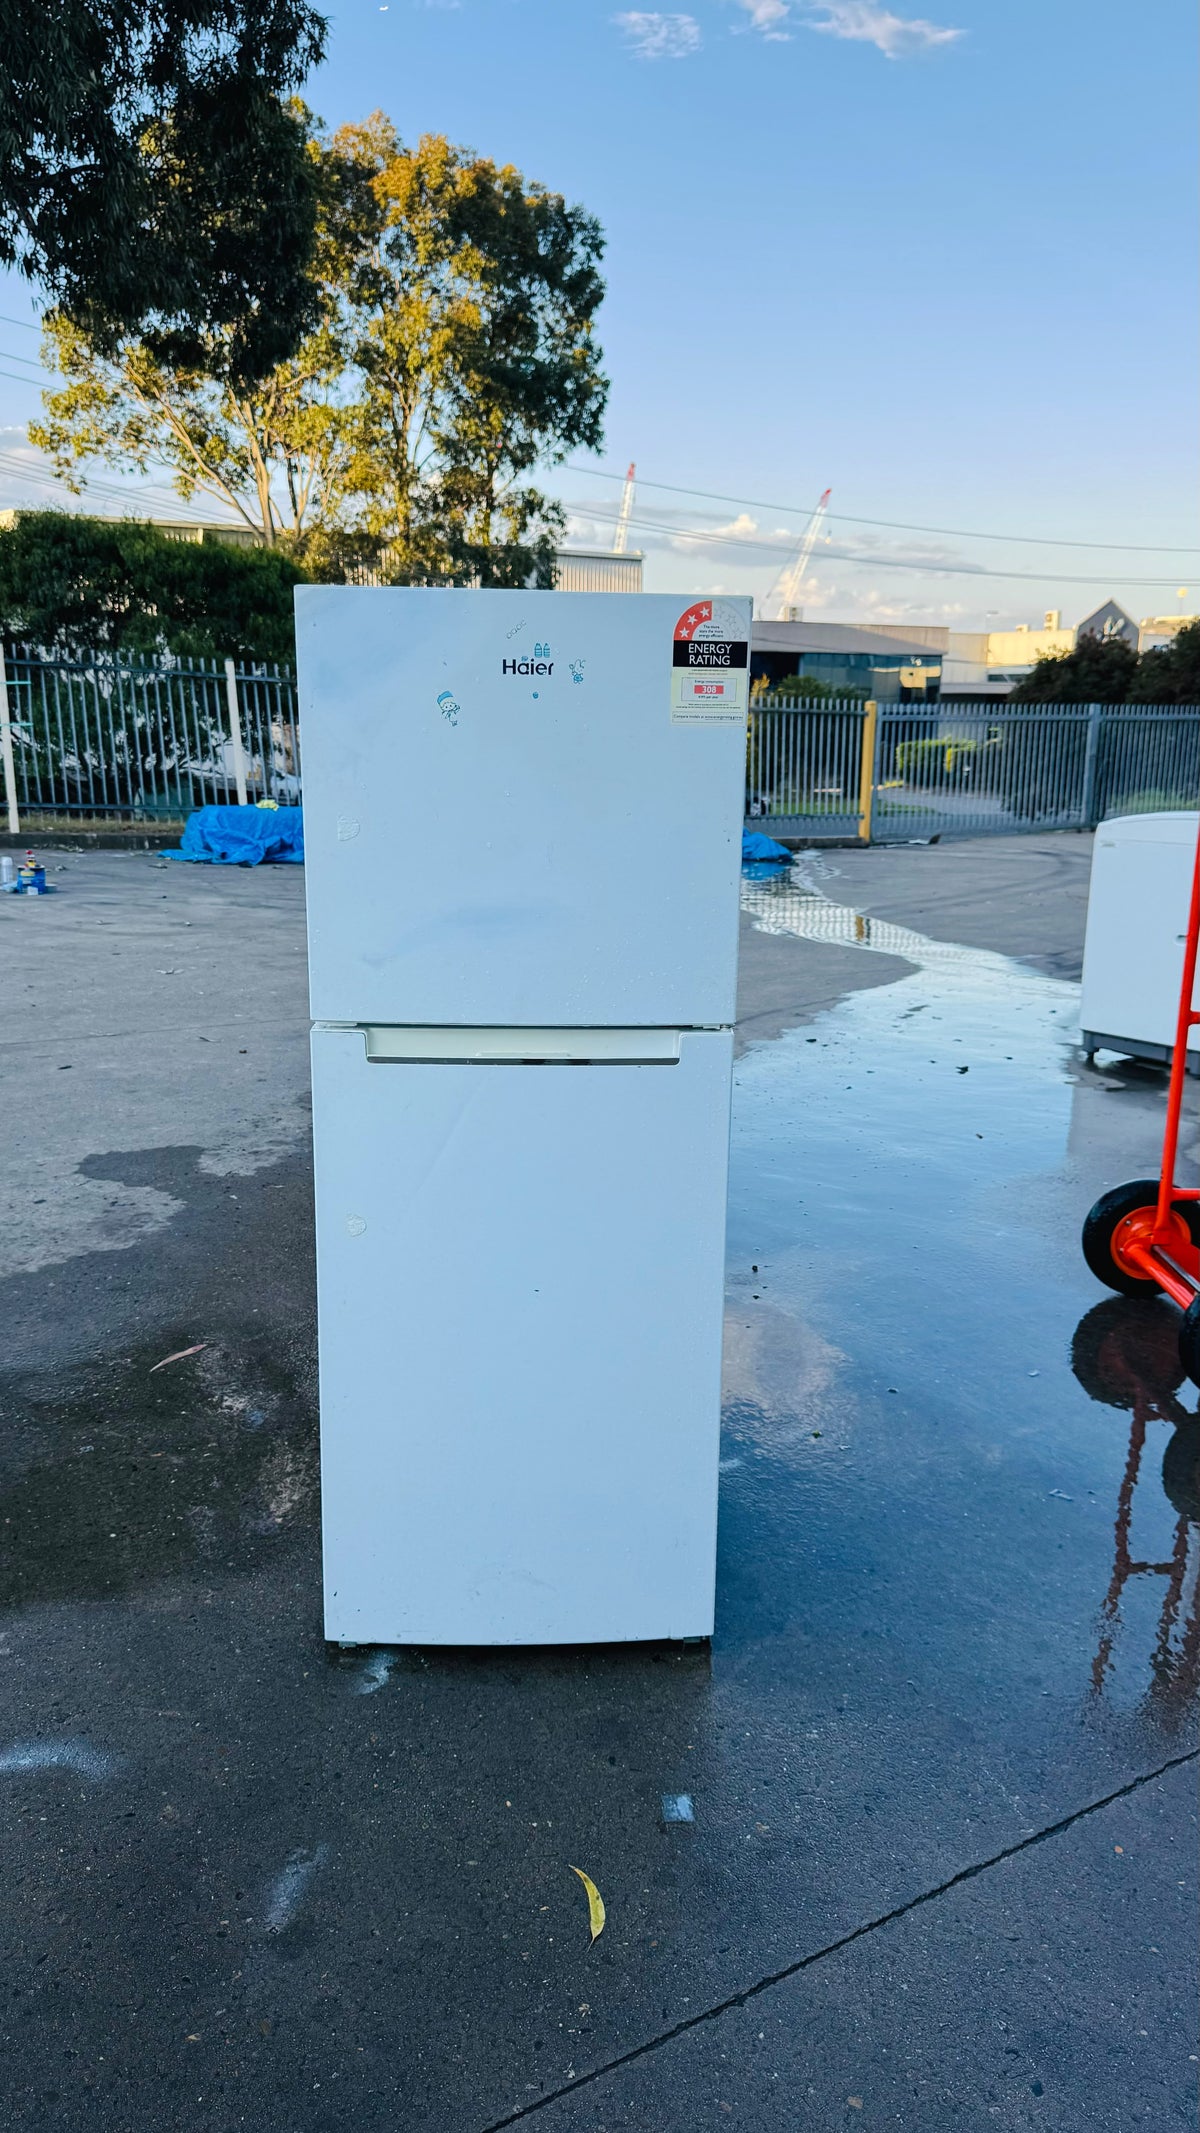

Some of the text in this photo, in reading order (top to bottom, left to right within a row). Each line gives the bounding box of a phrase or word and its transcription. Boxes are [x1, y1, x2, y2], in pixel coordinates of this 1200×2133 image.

[688, 643, 732, 654] ENERGY
[689, 655, 731, 665] RATING
[503, 658, 554, 675] Haier
[702, 686, 717, 694] 308
